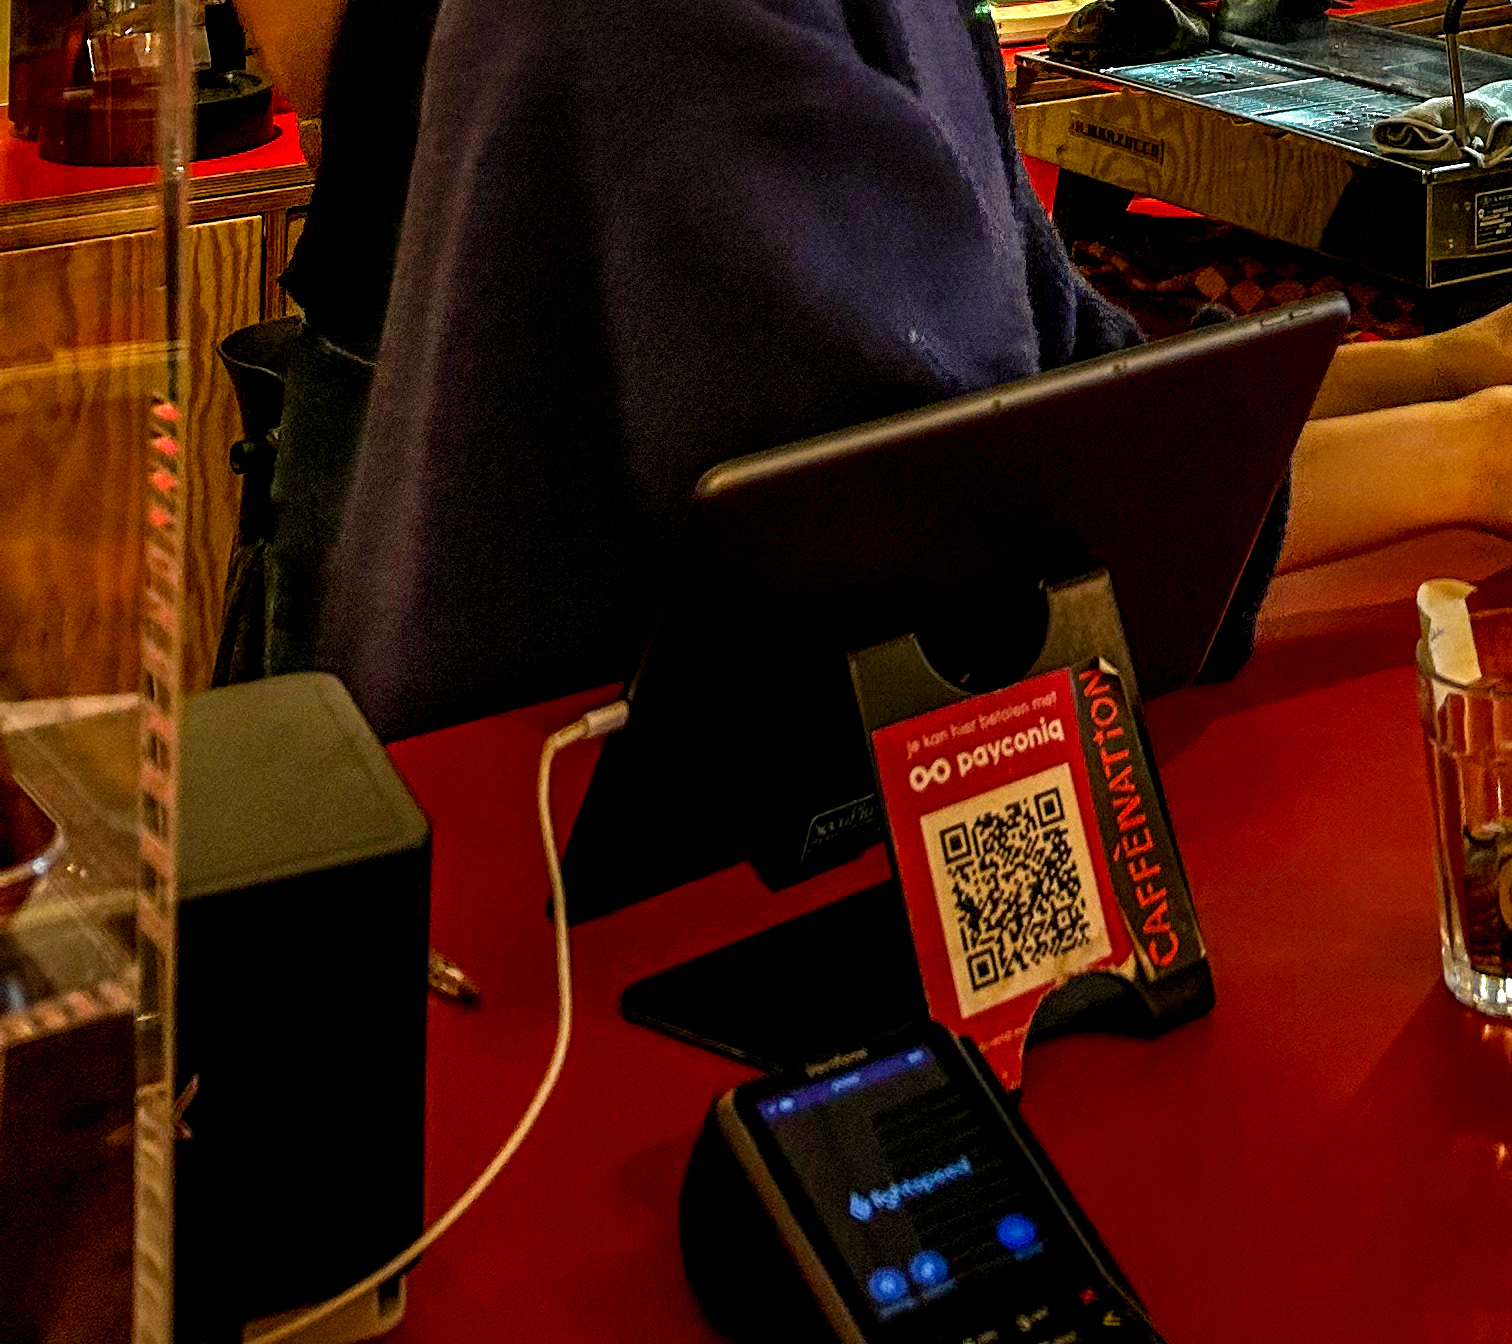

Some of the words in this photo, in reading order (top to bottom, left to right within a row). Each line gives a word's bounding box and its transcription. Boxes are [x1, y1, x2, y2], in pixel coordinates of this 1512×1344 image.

[921, 729, 949, 748] kan
[977, 702, 1030, 730] betalen
[956, 716, 1065, 778] payconiq
